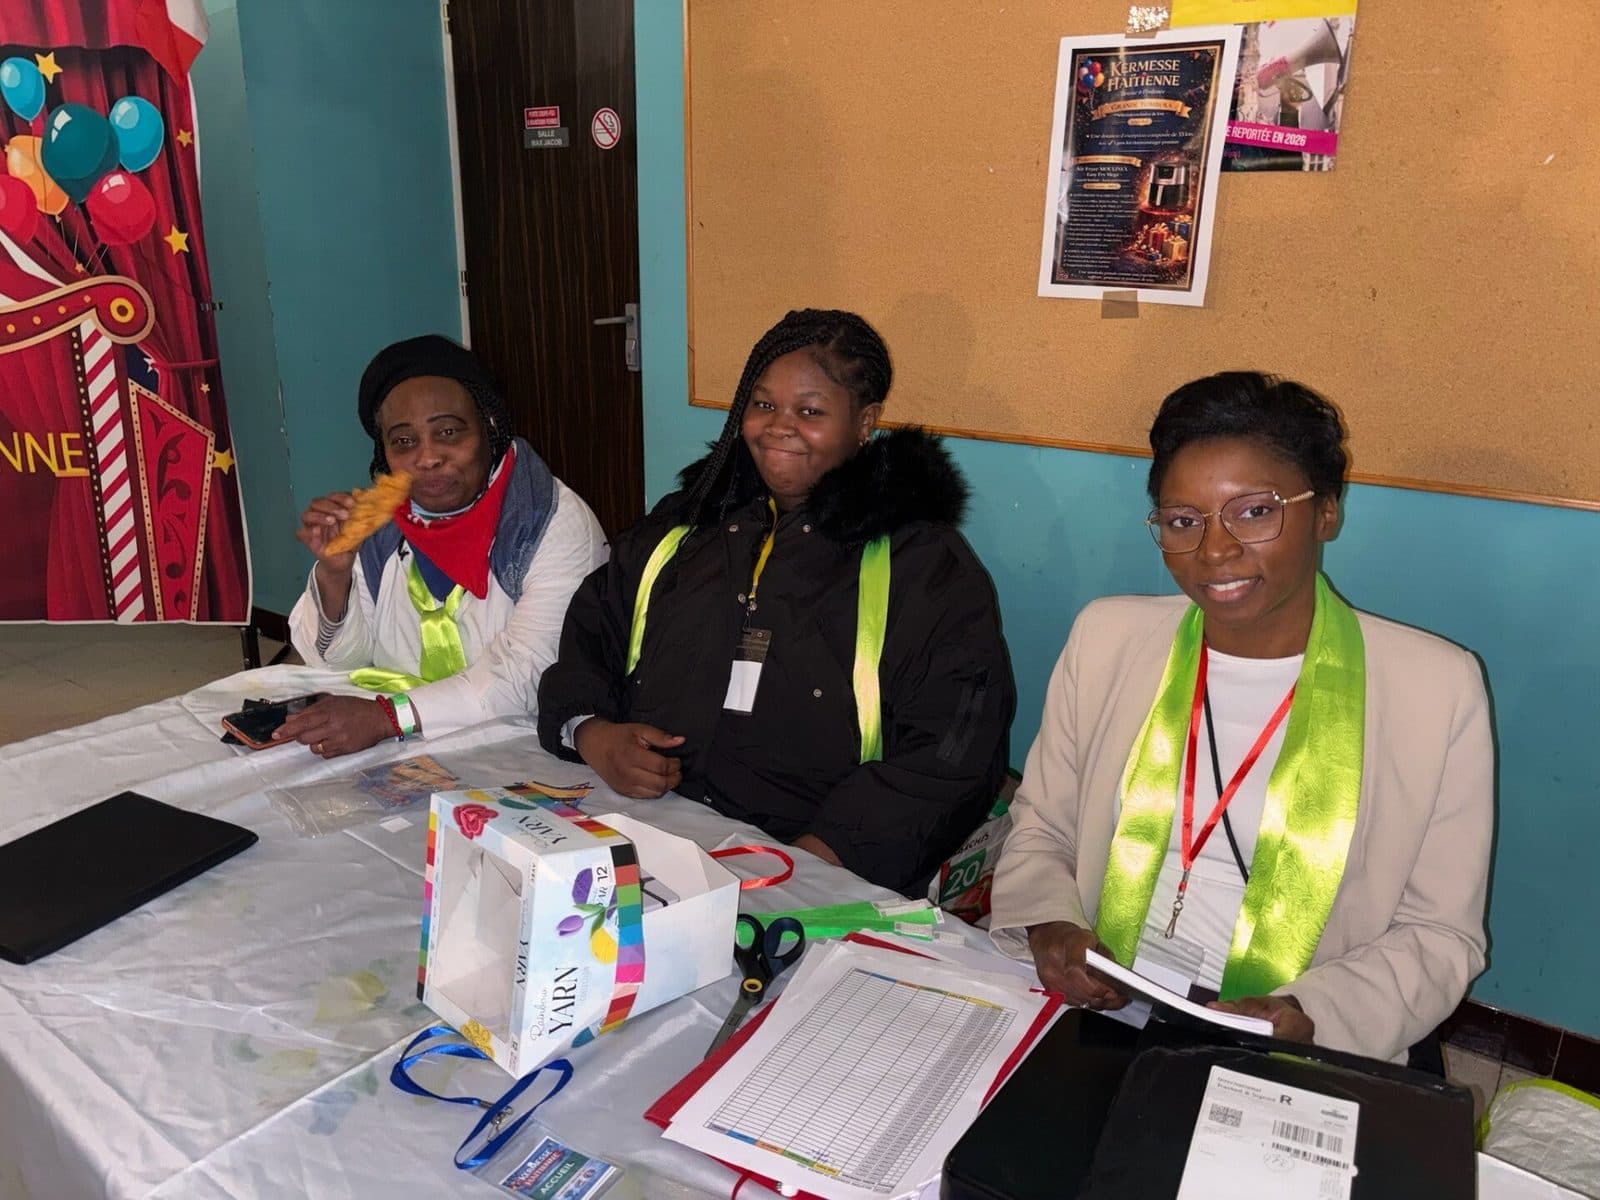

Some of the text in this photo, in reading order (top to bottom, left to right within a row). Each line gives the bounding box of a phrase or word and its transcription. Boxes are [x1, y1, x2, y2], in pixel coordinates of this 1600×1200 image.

[1110, 60, 1180, 77] KERMESSE
[1107, 73, 1180, 92] HAÏTIENNE
[1232, 126, 1272, 142] REPORTÉE
[1272, 131, 1284, 143] EN
[1284, 133, 1307, 146] 2026
[596, 866, 608, 882] 12
[943, 860, 980, 897] 20
[549, 967, 578, 1034] YARN
[1279, 1094, 1293, 1106] R
[540, 1161, 576, 1195] ACCUEIL
